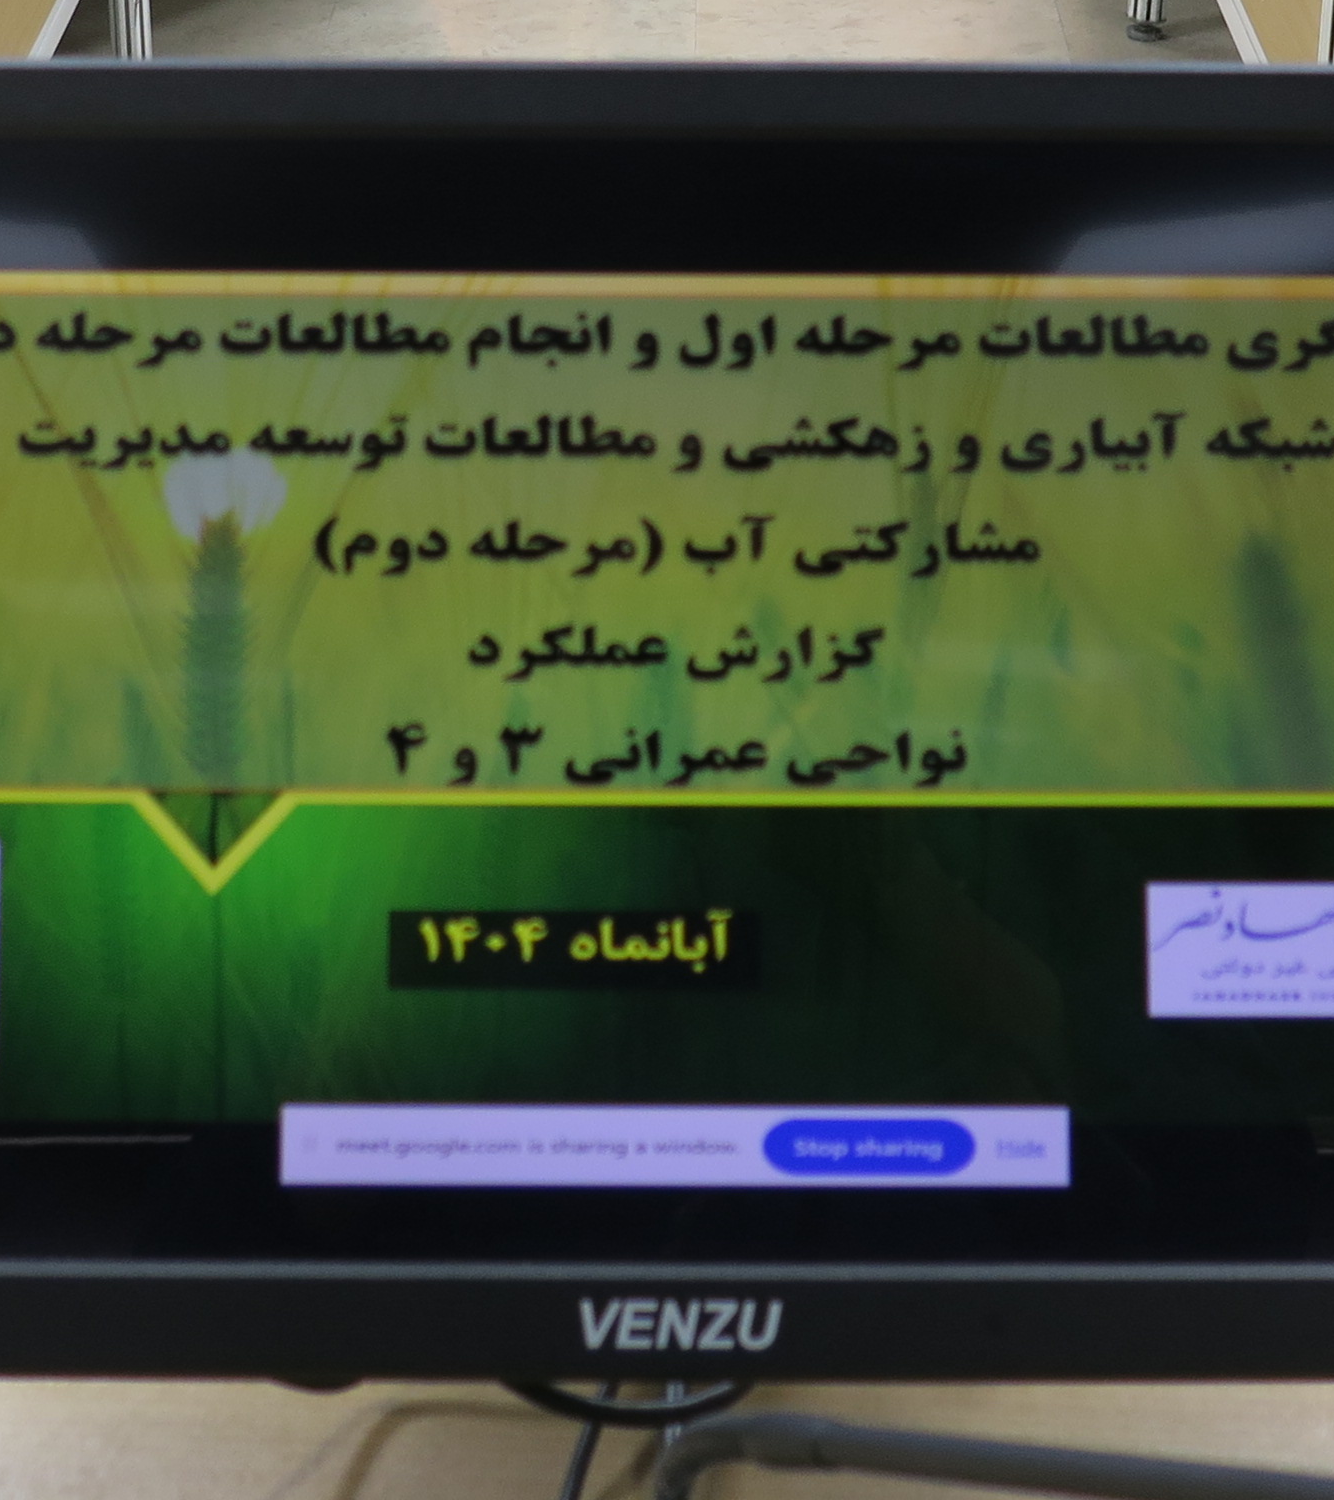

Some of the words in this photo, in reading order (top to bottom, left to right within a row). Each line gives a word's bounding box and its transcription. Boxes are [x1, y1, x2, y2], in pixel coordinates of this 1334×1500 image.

[36, 310, 203, 368] مرحله
[219, 310, 451, 356] مطالعات
[467, 312, 612, 368] انجام
[631, 330, 660, 370] و
[679, 312, 777, 371] اول
[795, 314, 962, 371] مرحله
[978, 313, 1210, 360] مطالعات
[18, 421, 231, 470] مدیریت
[249, 414, 407, 472] توسعه
[424, 413, 657, 459] مطالعات
[674, 432, 704, 473] و
[722, 415, 932, 475] زهکشی
[952, 432, 982, 474] و
[1000, 410, 1185, 474] آبیاری
[683, 514, 774, 574] آب
[794, 519, 1042, 580] مشارکتی
[468, 623, 669, 682] عملکرد
[386, 722, 426, 773] ۴
[450, 746, 479, 786] و
[499, 725, 544, 775] ۳
[564, 728, 768, 788] عمرانی
[785, 729, 968, 788] نواحی
[419, 915, 549, 964] ۱۴۰۴
[569, 908, 733, 974] آبانماه
[336, 1137, 521, 1159] meet.google.com
[527, 1137, 545, 1154] is
[550, 1137, 629, 1160] sharing
[793, 1137, 849, 1161] Stop
[855, 1136, 945, 1162] sharing
[996, 1139, 1047, 1158] Hide
[579, 1298, 783, 1351] VENZU
